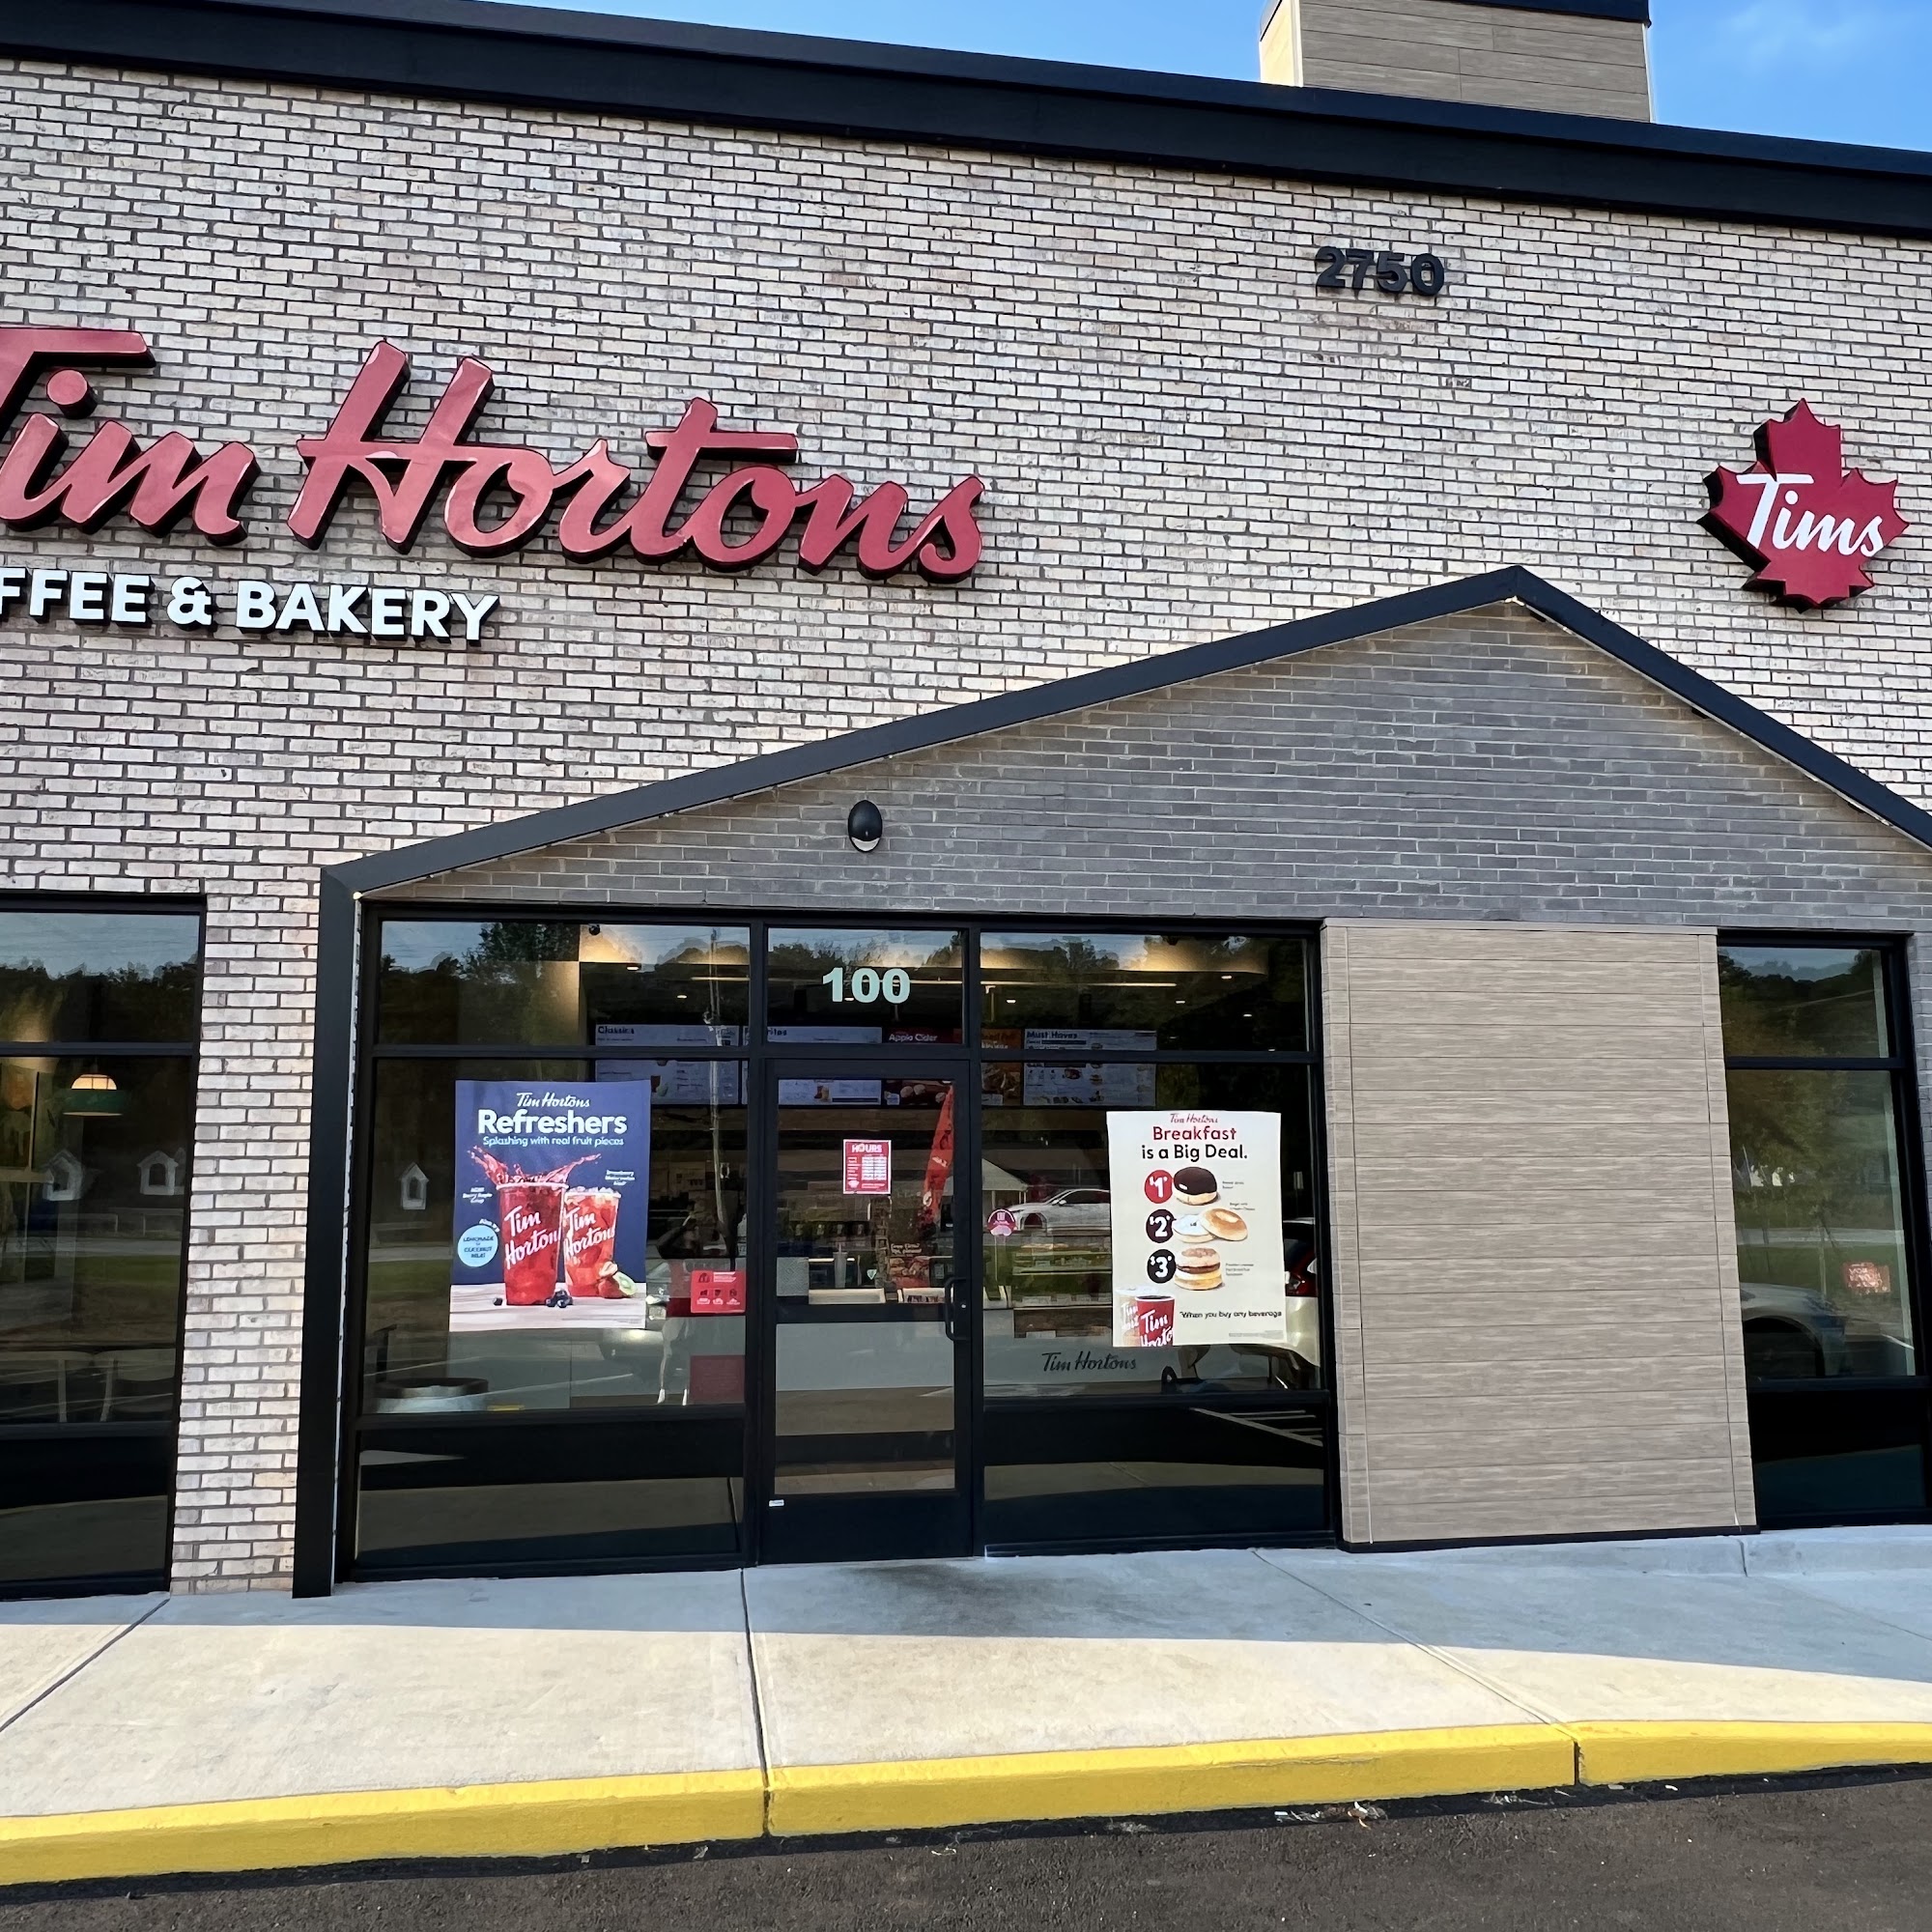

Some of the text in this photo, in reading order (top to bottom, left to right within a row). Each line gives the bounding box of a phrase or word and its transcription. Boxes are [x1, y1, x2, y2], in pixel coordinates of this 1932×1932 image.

[1316, 244, 1445, 298] 2750
[292, 339, 985, 582] Hortons
[1737, 472, 1886, 557] Tims
[167, 577, 214, 630] &
[237, 579, 499, 643] BAKERY
[822, 967, 910, 1004] 100
[889, 1033, 938, 1042] Apple Cider
[1026, 1030, 1078, 1039] Must Haves
[516, 1092, 591, 1108] Tim Hortons
[478, 1109, 628, 1135] Refreshers
[1170, 1113, 1219, 1124] Tim Hortons
[483, 1136, 625, 1148] Splashing with real fruit pieces
[1152, 1126, 1237, 1141] Breakfast
[851, 1144, 883, 1153] HOURS
[1142, 1144, 1248, 1162] is a Big Deal.
[504, 1205, 541, 1237] Tim
[565, 1207, 597, 1237] Tim
[1140, 1310, 1168, 1334] Tim
[1218, 1311, 1232, 1320] buy
[1248, 1311, 1282, 1320] beverage
[1041, 1350, 1137, 1373] Tim Hortons
